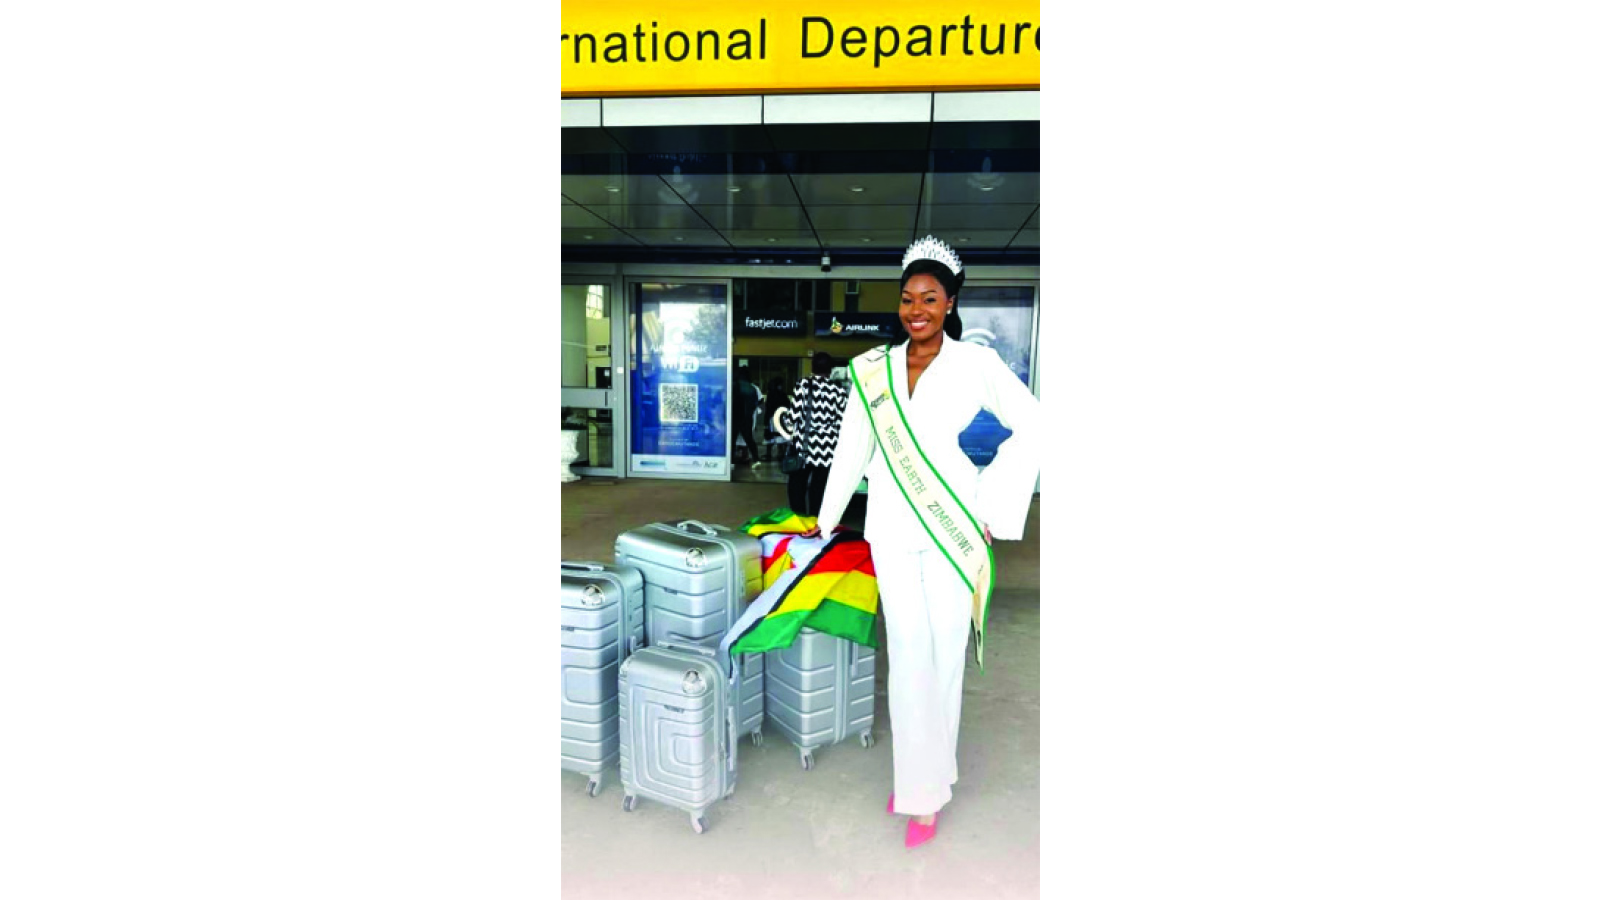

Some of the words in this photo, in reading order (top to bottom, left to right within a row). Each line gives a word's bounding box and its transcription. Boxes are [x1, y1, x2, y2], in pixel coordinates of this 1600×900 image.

[801, 15, 1040, 68] Departur
[745, 316, 798, 330] fastjet.com
[885, 425, 903, 454] MISS
[899, 455, 927, 495] EARTH
[927, 500, 974, 557] ZIMBABWE
